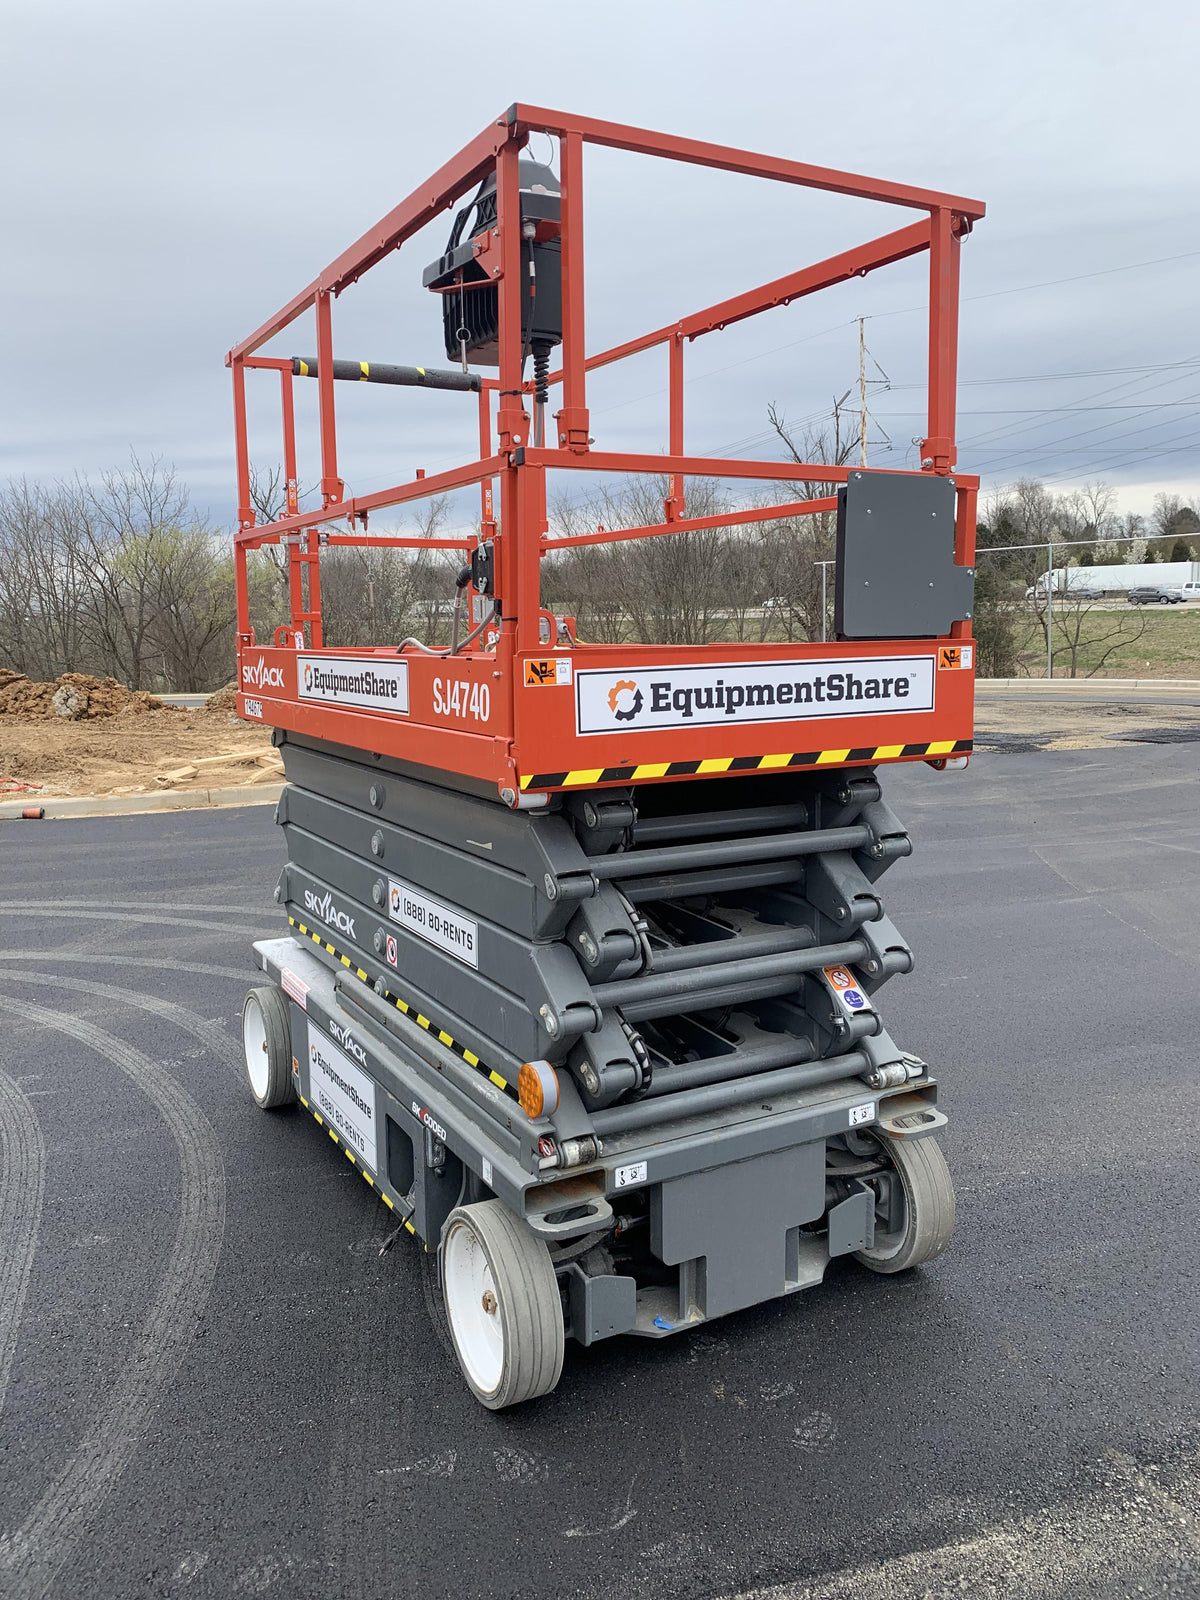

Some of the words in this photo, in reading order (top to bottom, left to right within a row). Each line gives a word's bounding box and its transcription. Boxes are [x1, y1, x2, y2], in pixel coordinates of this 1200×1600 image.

[242, 655, 285, 689] SKYJACK
[313, 667, 398, 698] EquipmentShare
[432, 677, 490, 722] SJ4740
[649, 673, 909, 718] EquipmentShare
[304, 889, 357, 940] SKYJACK
[403, 897, 426, 926] (888)
[427, 912, 473, 951] 80-RENTS
[329, 1019, 368, 1067] SKYJACK
[317, 1052, 372, 1119] EquipmentShare
